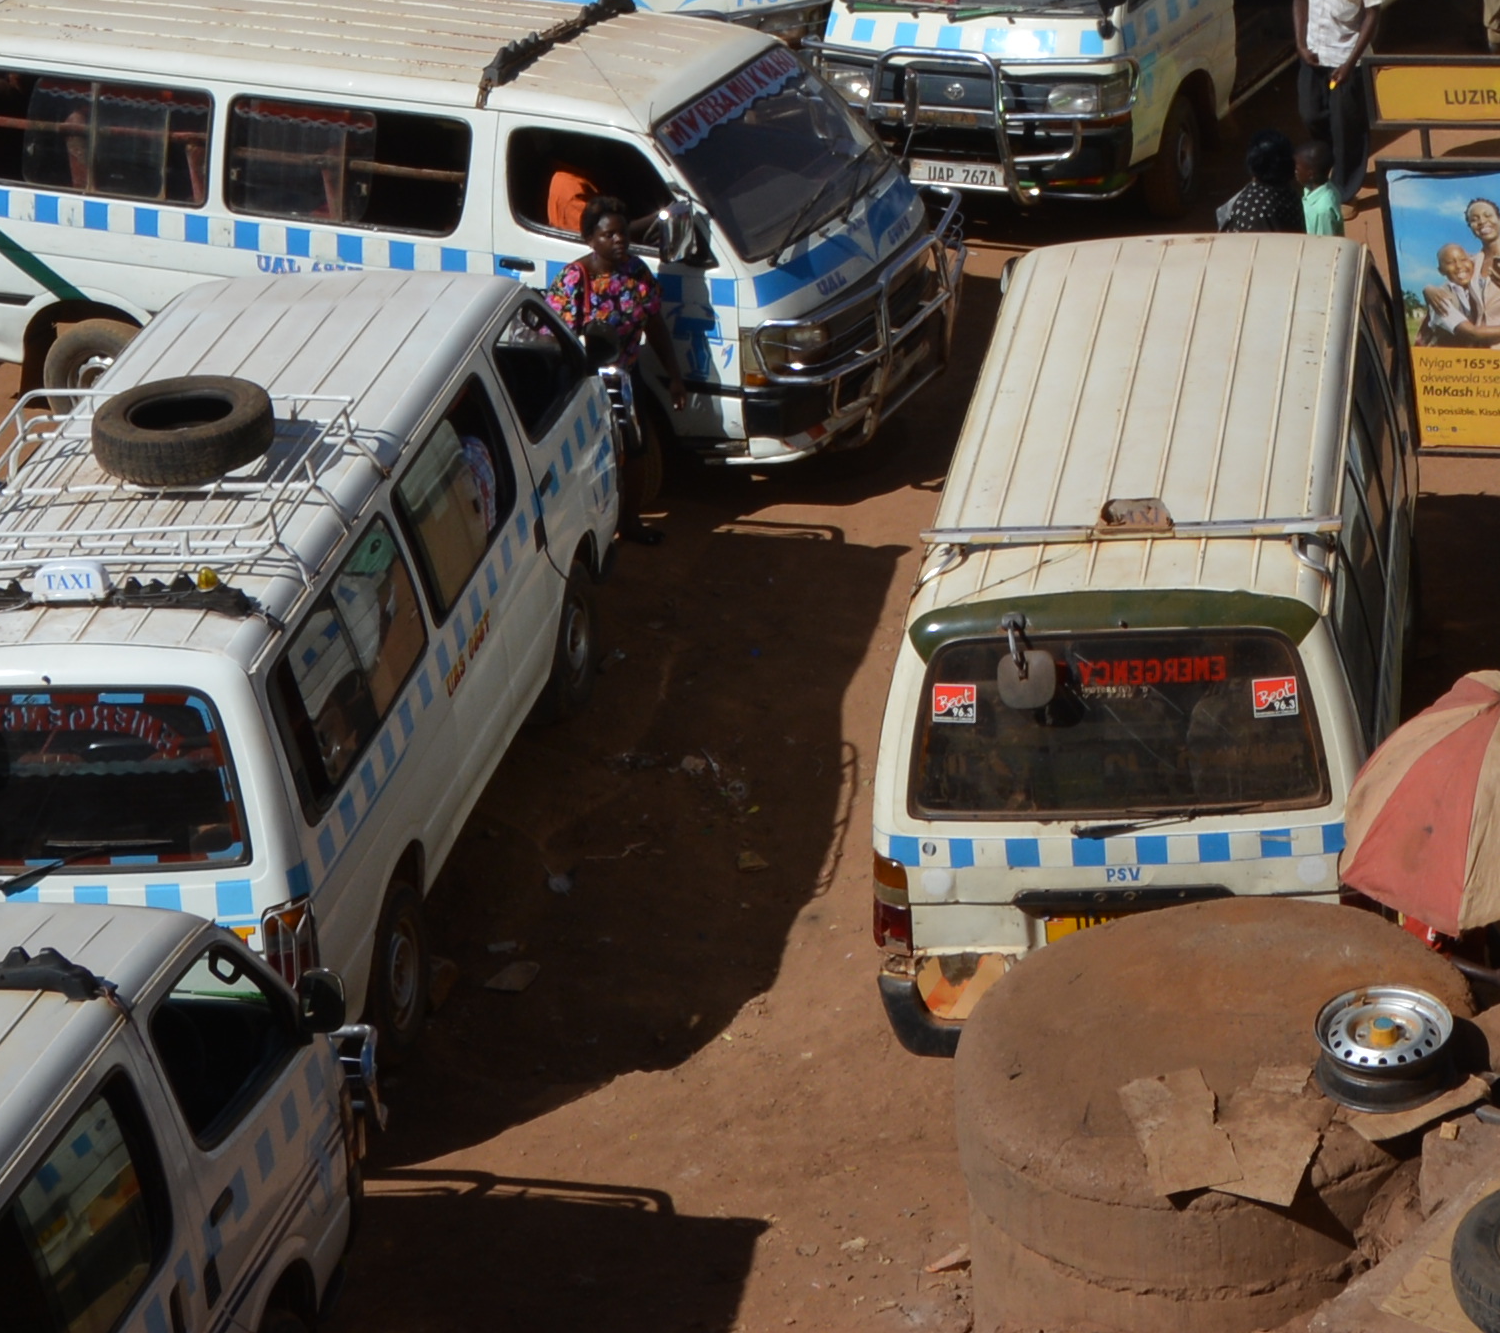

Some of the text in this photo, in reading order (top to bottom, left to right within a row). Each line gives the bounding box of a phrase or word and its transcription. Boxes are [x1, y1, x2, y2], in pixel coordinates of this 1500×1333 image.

[928, 165, 997, 187] UAP 767A
[1418, 355, 1454, 373] Nyiga
[1422, 384, 1474, 398] MoKash
[1475, 386, 1491, 399] ku
[42, 573, 93, 591] TAXI
[937, 687, 973, 710] Beat
[1256, 679, 1293, 705] Beat
[952, 706, 974, 719] 96.3
[1273, 698, 1296, 712] 96.3
[1104, 864, 1141, 882] PSV
